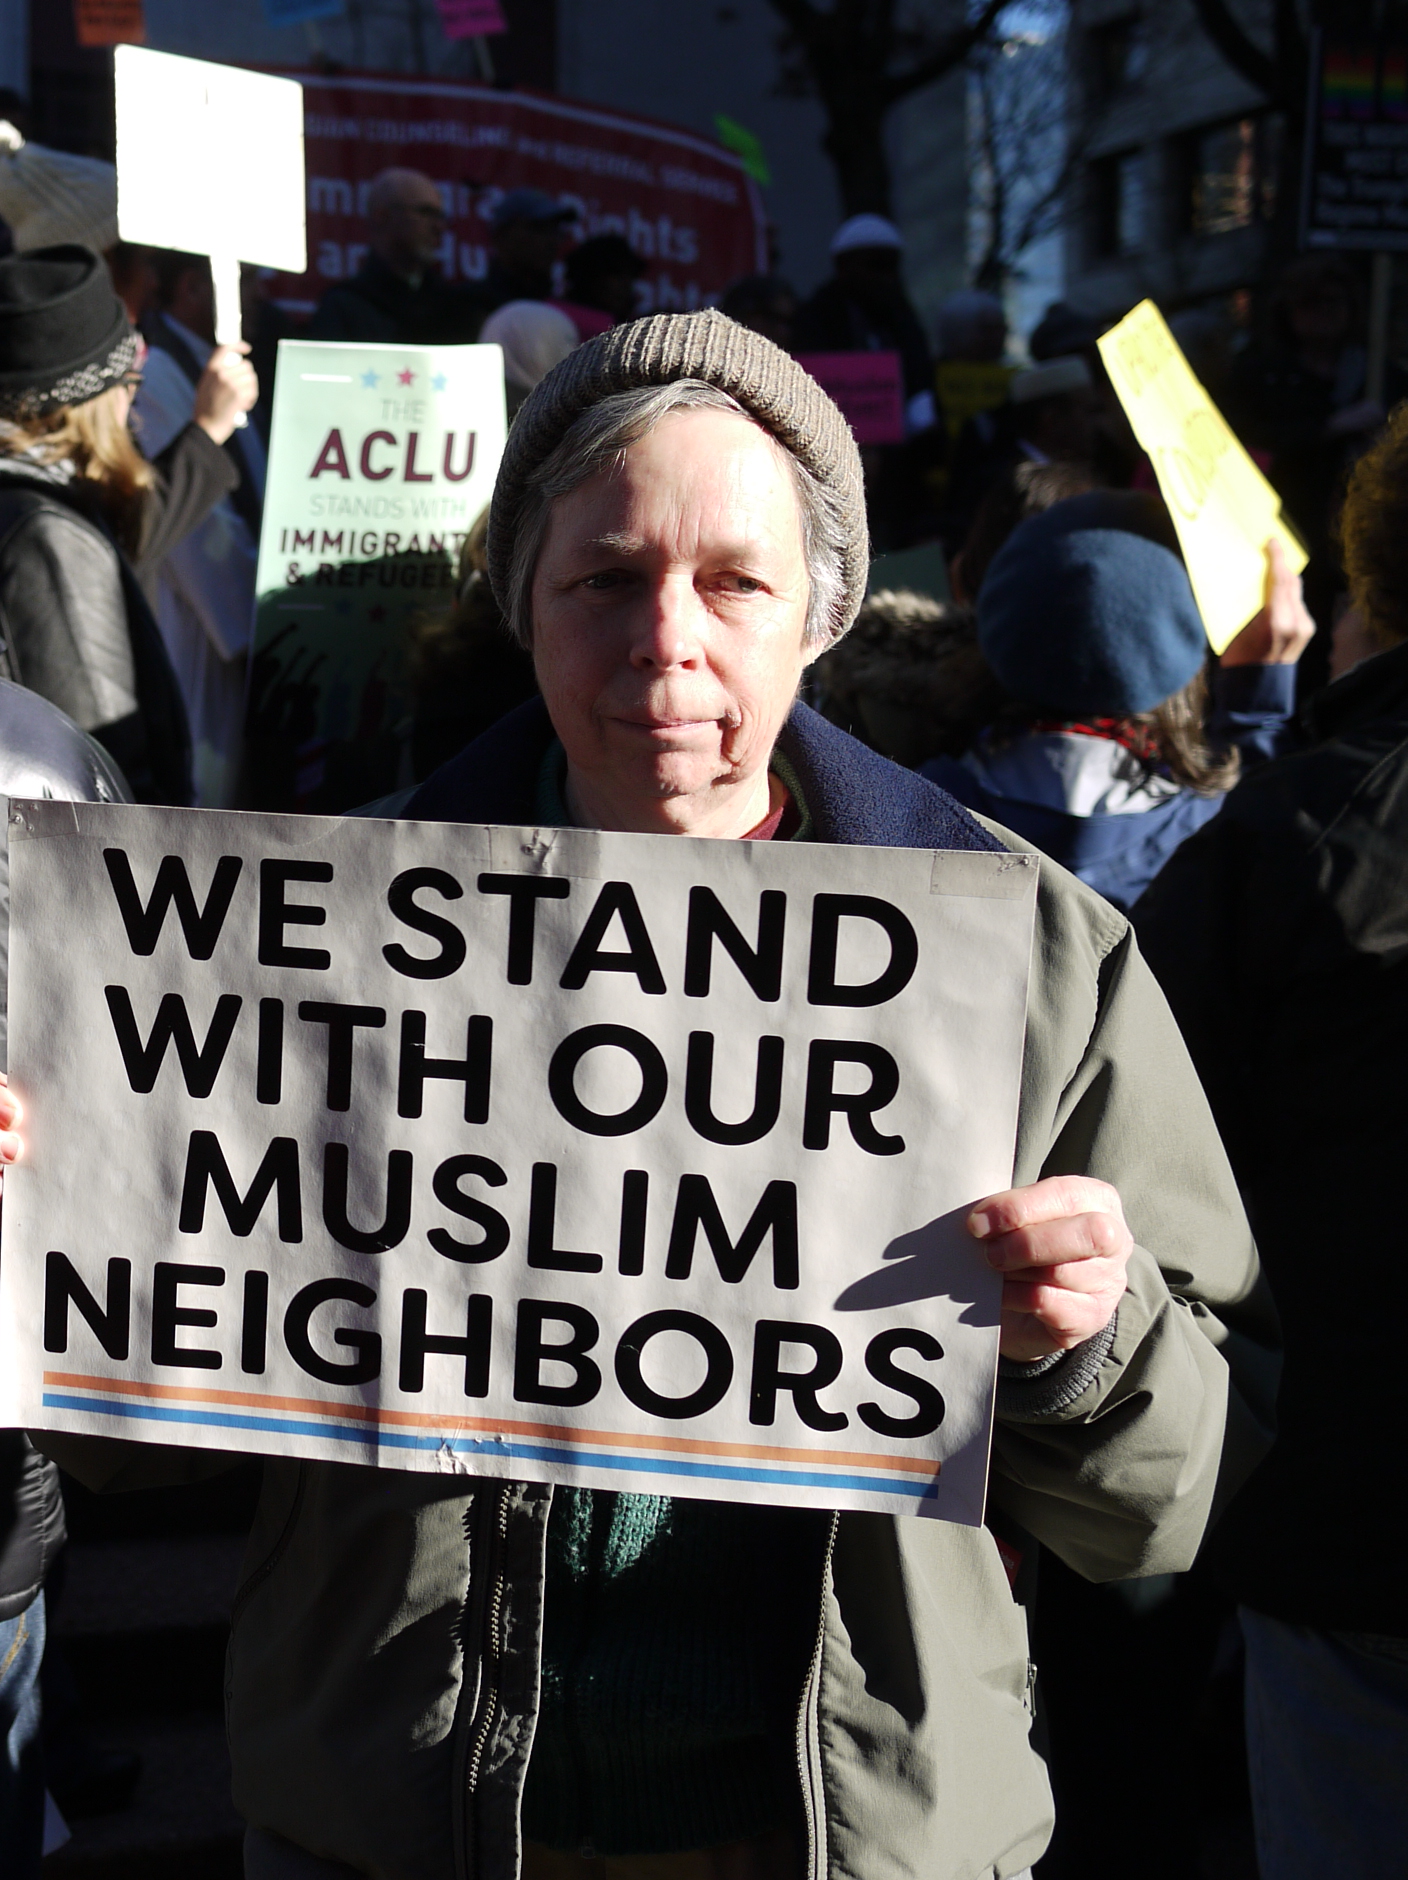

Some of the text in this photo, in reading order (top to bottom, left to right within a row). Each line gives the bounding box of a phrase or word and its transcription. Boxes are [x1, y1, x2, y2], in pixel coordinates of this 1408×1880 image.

[380, 398, 427, 423] THE
[307, 425, 478, 485] ACLU
[309, 493, 467, 520] STANDS WITH
[280, 528, 469, 558] IMMIGRANT
[286, 562, 454, 588] & REFUGEE
[101, 847, 920, 1009] WE STAND
[103, 984, 907, 1157] WITH OUR
[177, 1129, 801, 1291] MUSLIM
[42, 1250, 947, 1440] NEIGHBORS
